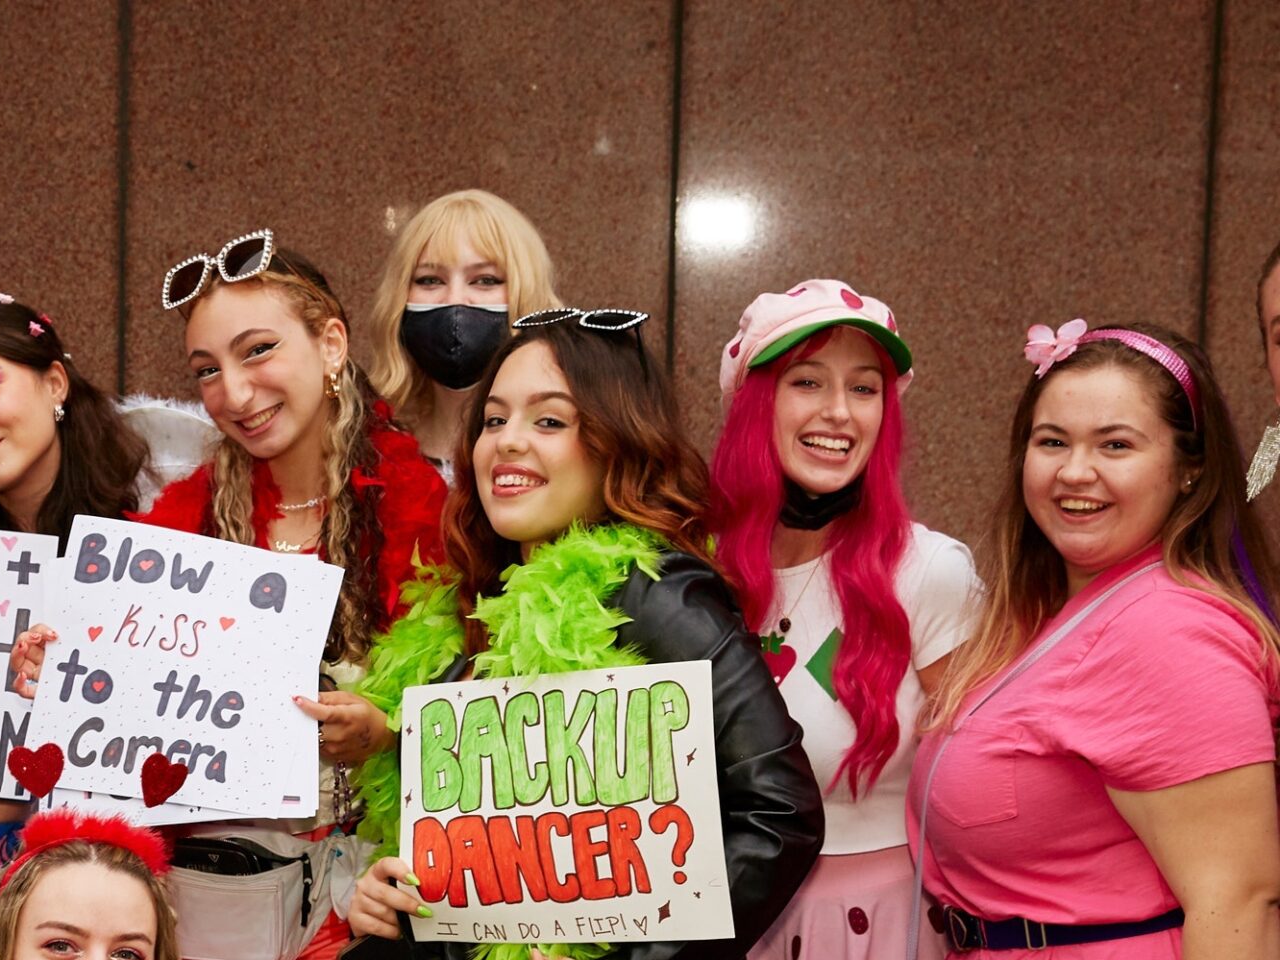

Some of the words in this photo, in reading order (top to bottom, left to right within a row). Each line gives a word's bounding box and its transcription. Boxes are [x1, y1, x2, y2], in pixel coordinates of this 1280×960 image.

[6, 549, 40, 585] +
[74, 532, 214, 594] Blow
[249, 571, 288, 613] a
[56, 648, 114, 704] to
[153, 669, 245, 730] the
[67, 716, 228, 784] Camera
[420, 680, 690, 812] BACKUP
[413, 805, 694, 907] DANCER?
[437, 921, 459, 937] I
[473, 920, 508, 941] CAN
[518, 920, 541, 940] DO
[554, 919, 567, 937] A
